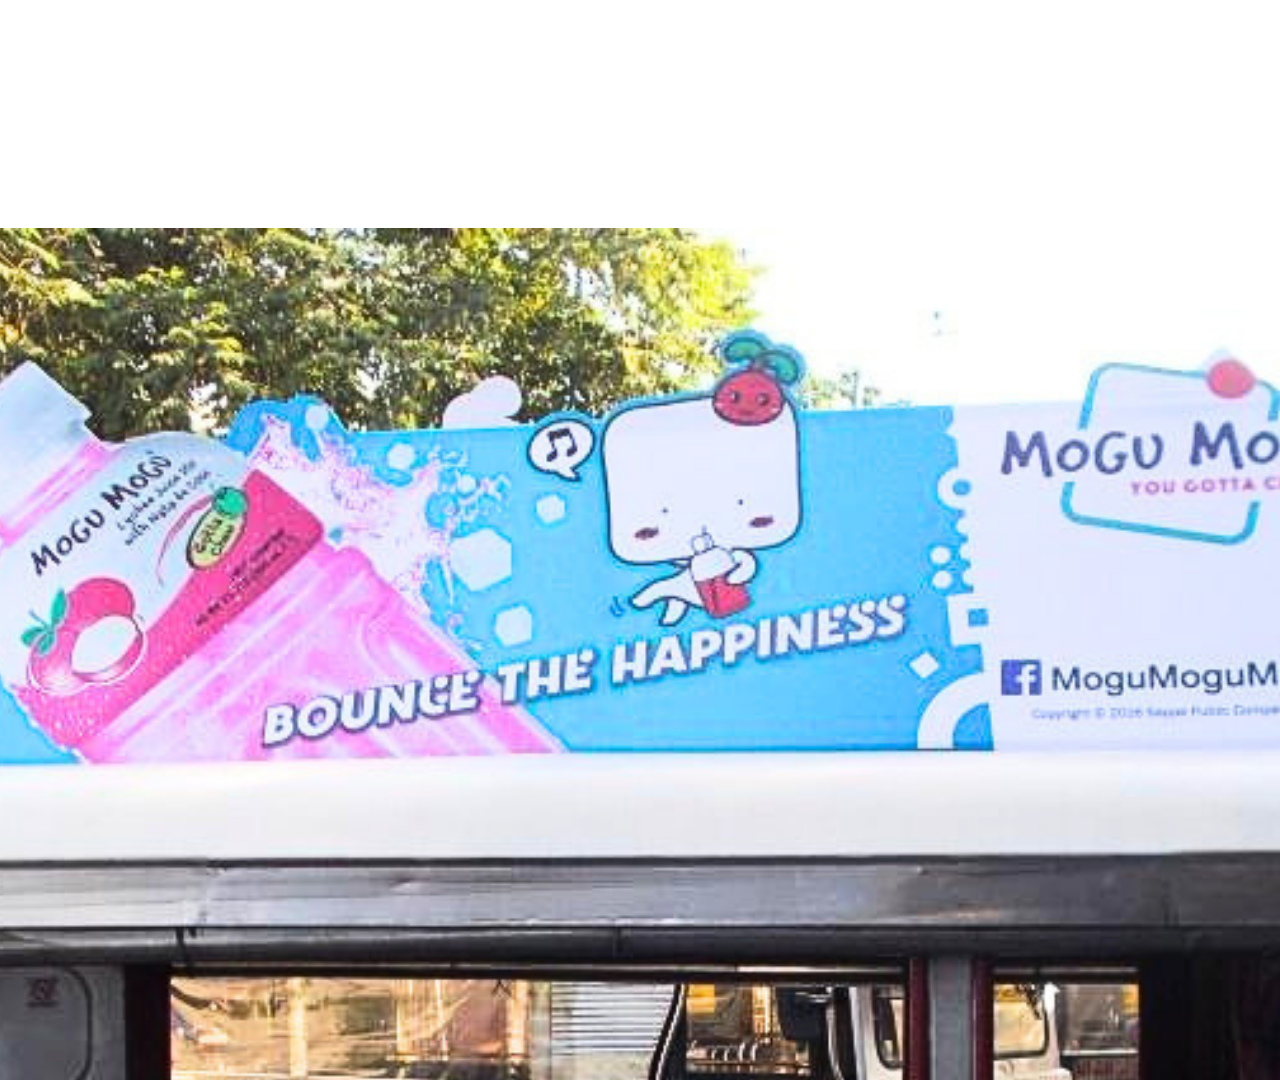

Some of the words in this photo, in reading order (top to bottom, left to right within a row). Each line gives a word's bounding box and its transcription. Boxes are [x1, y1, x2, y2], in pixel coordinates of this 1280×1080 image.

[1131, 479, 1177, 495] YOU
[1183, 476, 1255, 494] GOTTA
[262, 670, 481, 748] BOUNCE
[495, 650, 595, 704] THE
[611, 596, 906, 685] HAPPINESS
